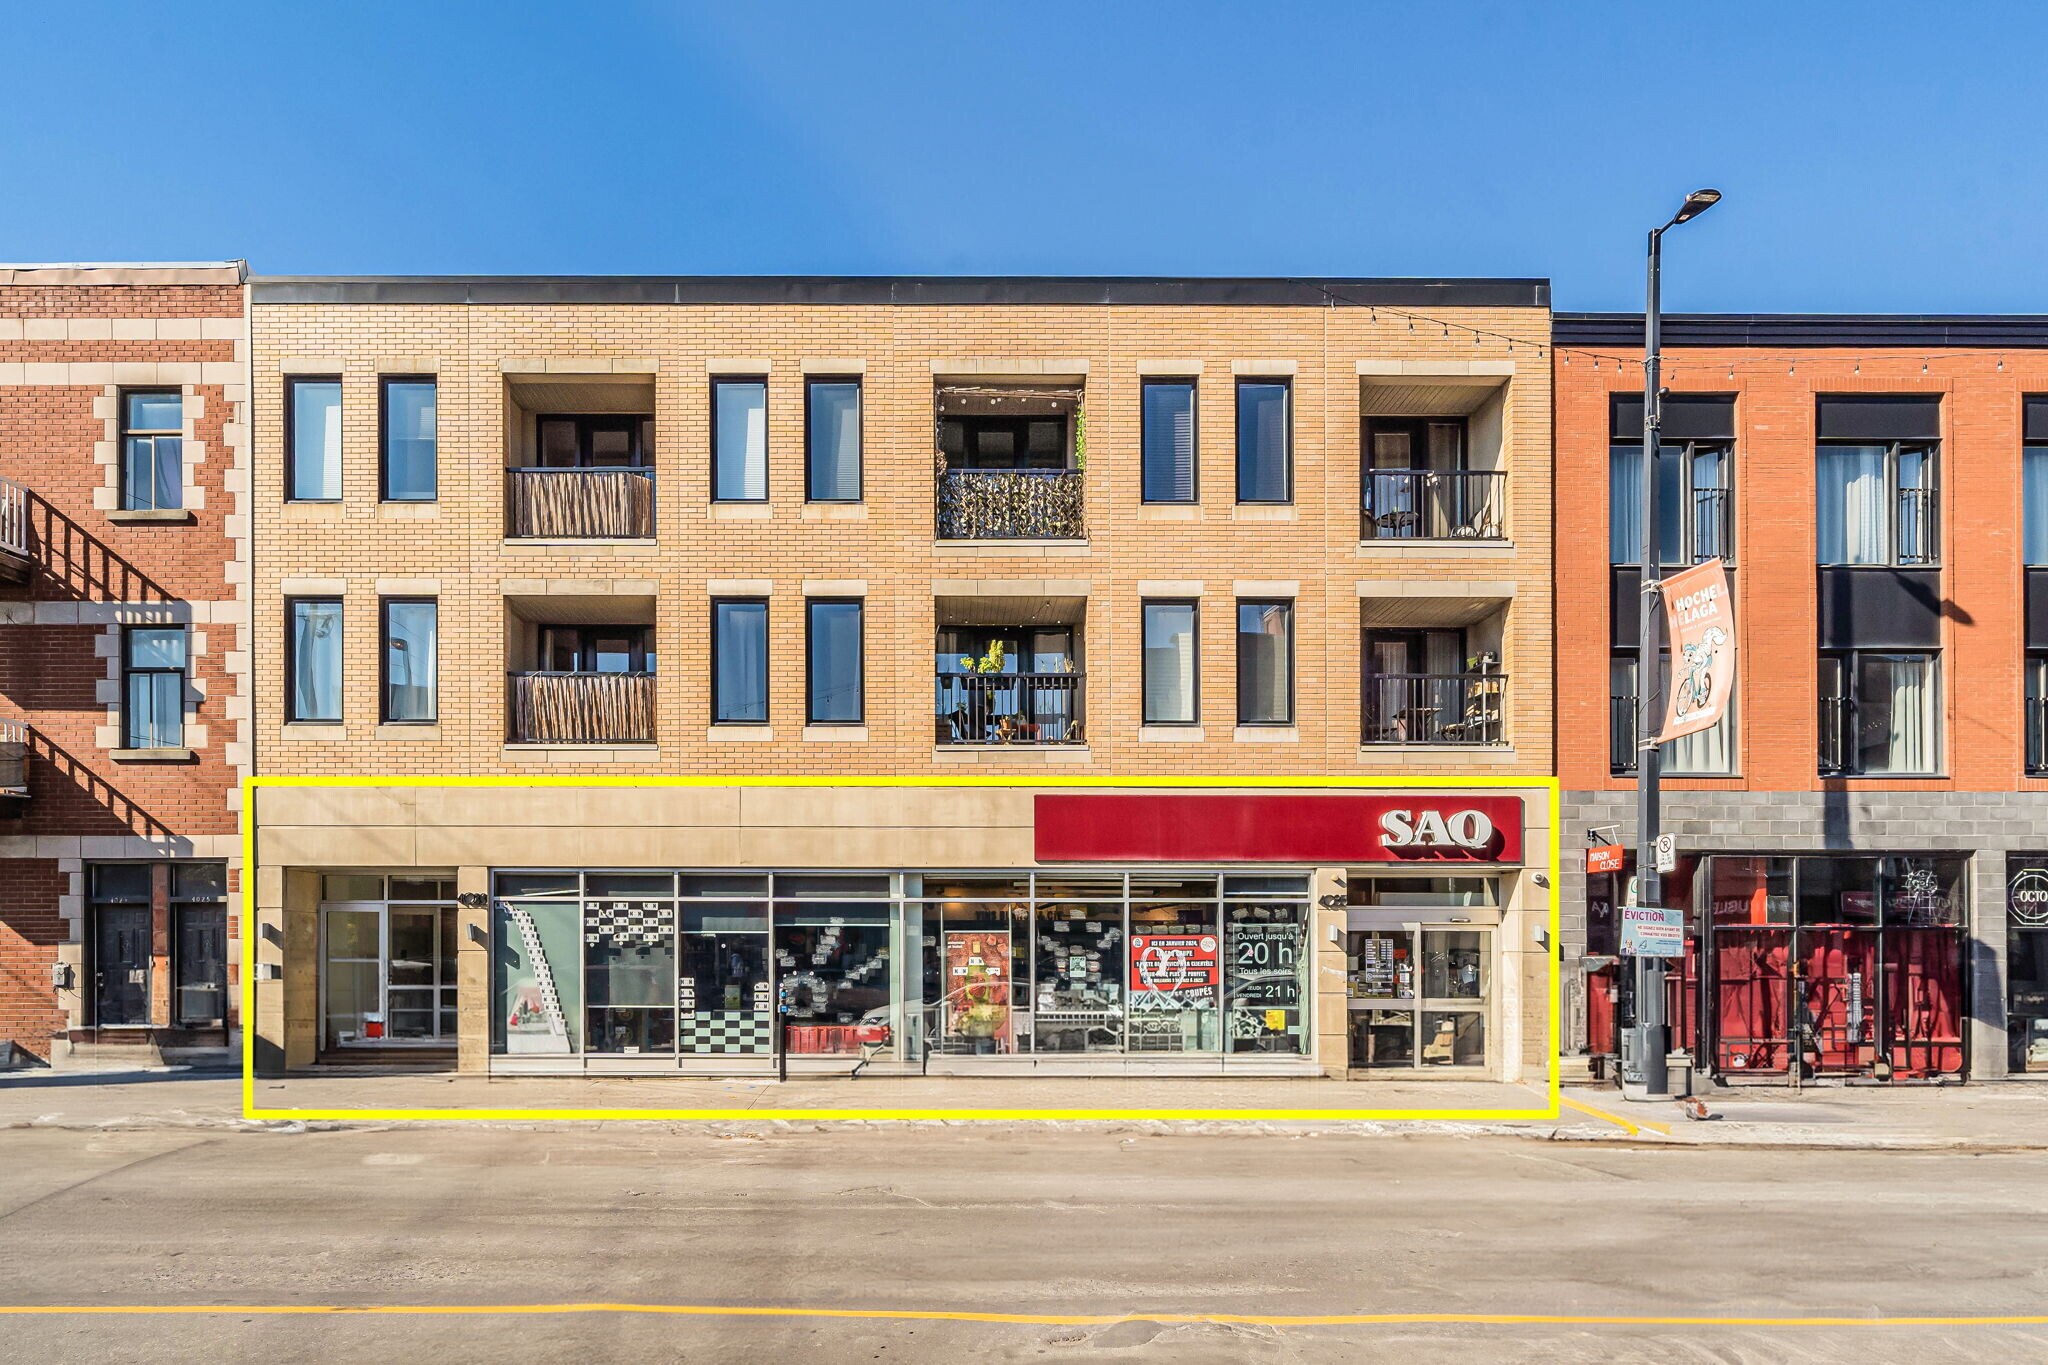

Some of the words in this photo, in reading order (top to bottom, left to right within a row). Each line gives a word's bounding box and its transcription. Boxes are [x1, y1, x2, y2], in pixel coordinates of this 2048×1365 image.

[1380, 809, 1492, 849] SAQ
[1589, 850, 1611, 863] MAISON
[1600, 858, 1620, 870] CLOSE
[1624, 907, 1665, 922] ÉVICTION
[1237, 932, 1264, 940] Ouvert
[1265, 932, 1294, 942] jusqu'à
[1238, 942, 1269, 965] 20
[1278, 942, 1293, 964] h
[1239, 967, 1258, 975] Tous
[1260, 967, 1272, 975] les
[1273, 967, 1293, 975] soirs
[1184, 985, 1214, 998] COUPÉS
[1265, 985, 1281, 998] 21
[1287, 985, 1296, 998] h
